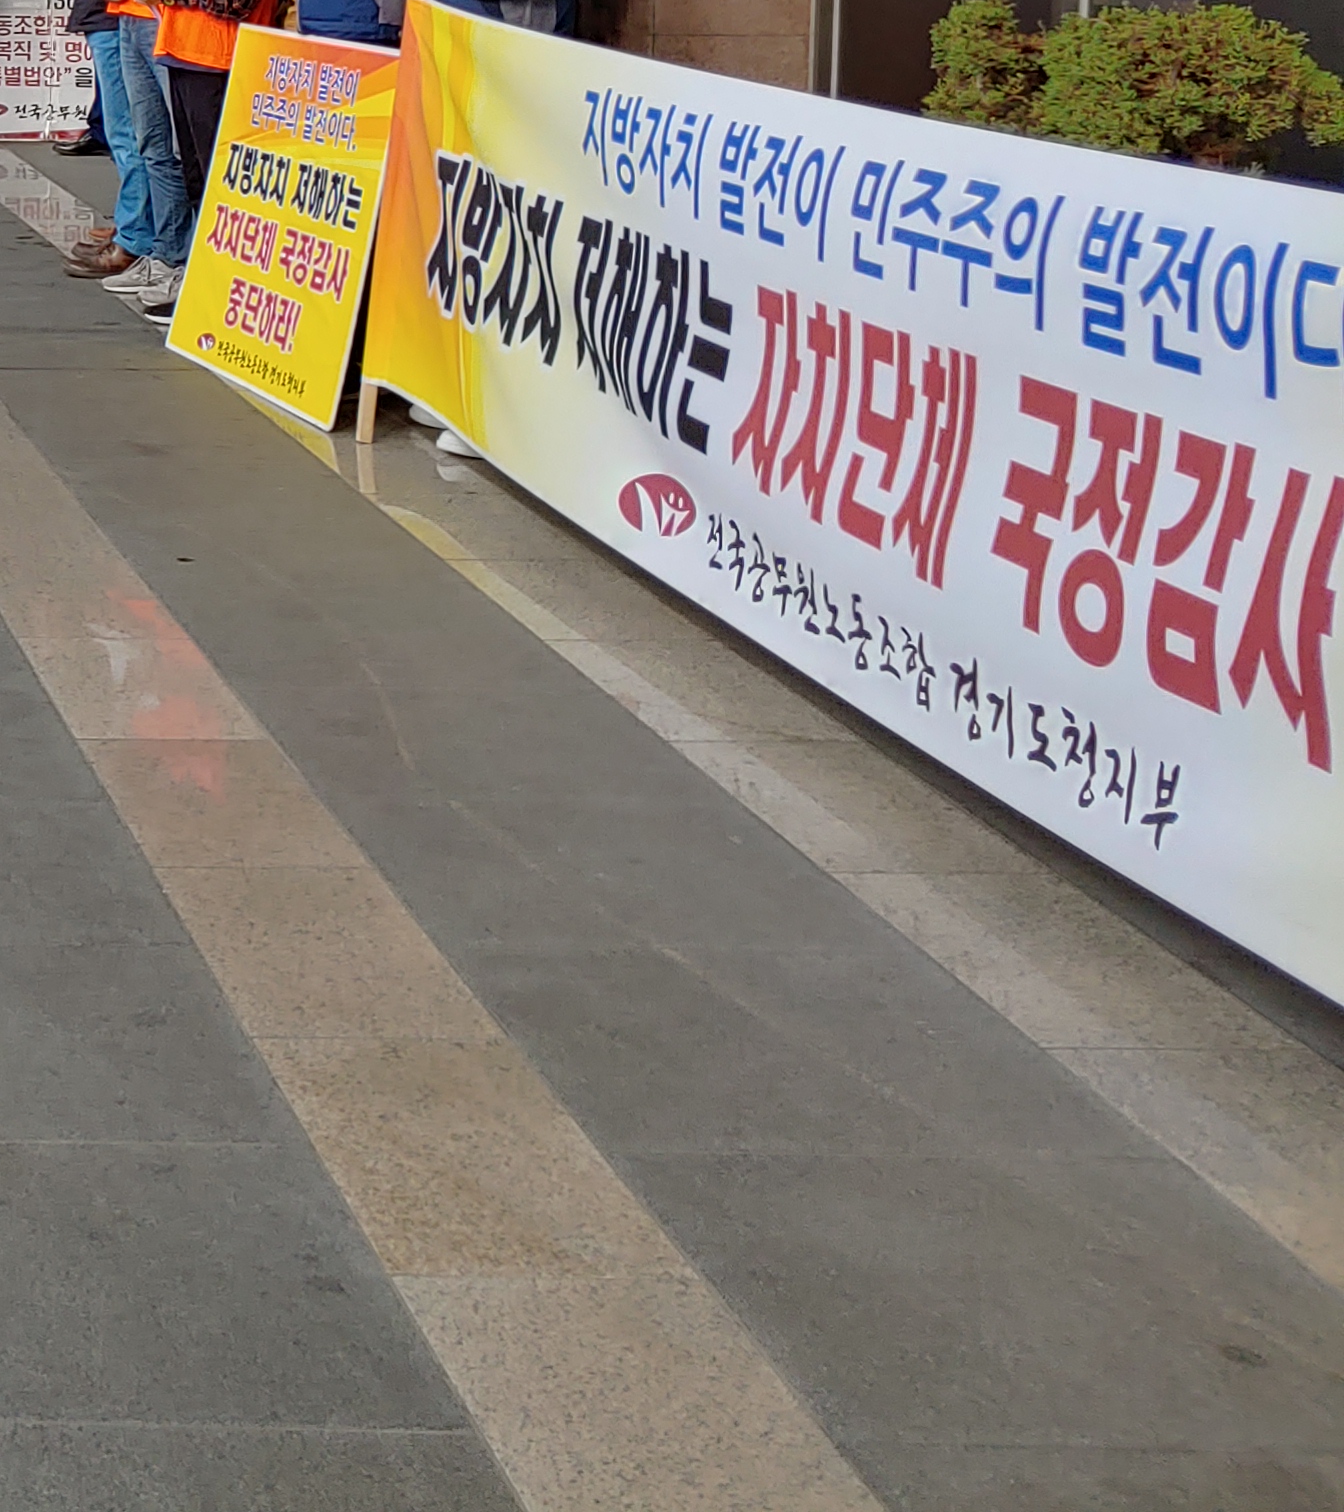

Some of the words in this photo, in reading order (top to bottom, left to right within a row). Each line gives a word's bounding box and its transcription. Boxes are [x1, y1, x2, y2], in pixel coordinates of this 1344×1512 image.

[39, 40, 57, 63] 및
[264, 55, 315, 100] 지방자치
[318, 64, 362, 109] 발전이
[250, 90, 300, 140] 민주주의
[301, 105, 359, 153] 발전이다.
[222, 141, 292, 210] 지방자치
[291, 161, 364, 233] 저해하는
[582, 86, 714, 223] 지방자치
[718, 119, 848, 261] 발전이
[849, 153, 1068, 332] 민주주의
[206, 202, 280, 275] 자치단체
[277, 226, 352, 305] 국정감사
[223, 274, 303, 356] 중단하라!
[426, 150, 565, 370] 지방자치
[571, 213, 735, 456] 저해하는
[730, 284, 979, 592] 자치단체
[990, 372, 1344, 775] 국정감사
[706, 510, 938, 712] 전국공무원노동조합
[951, 656, 1186, 852] 경기도청지부
